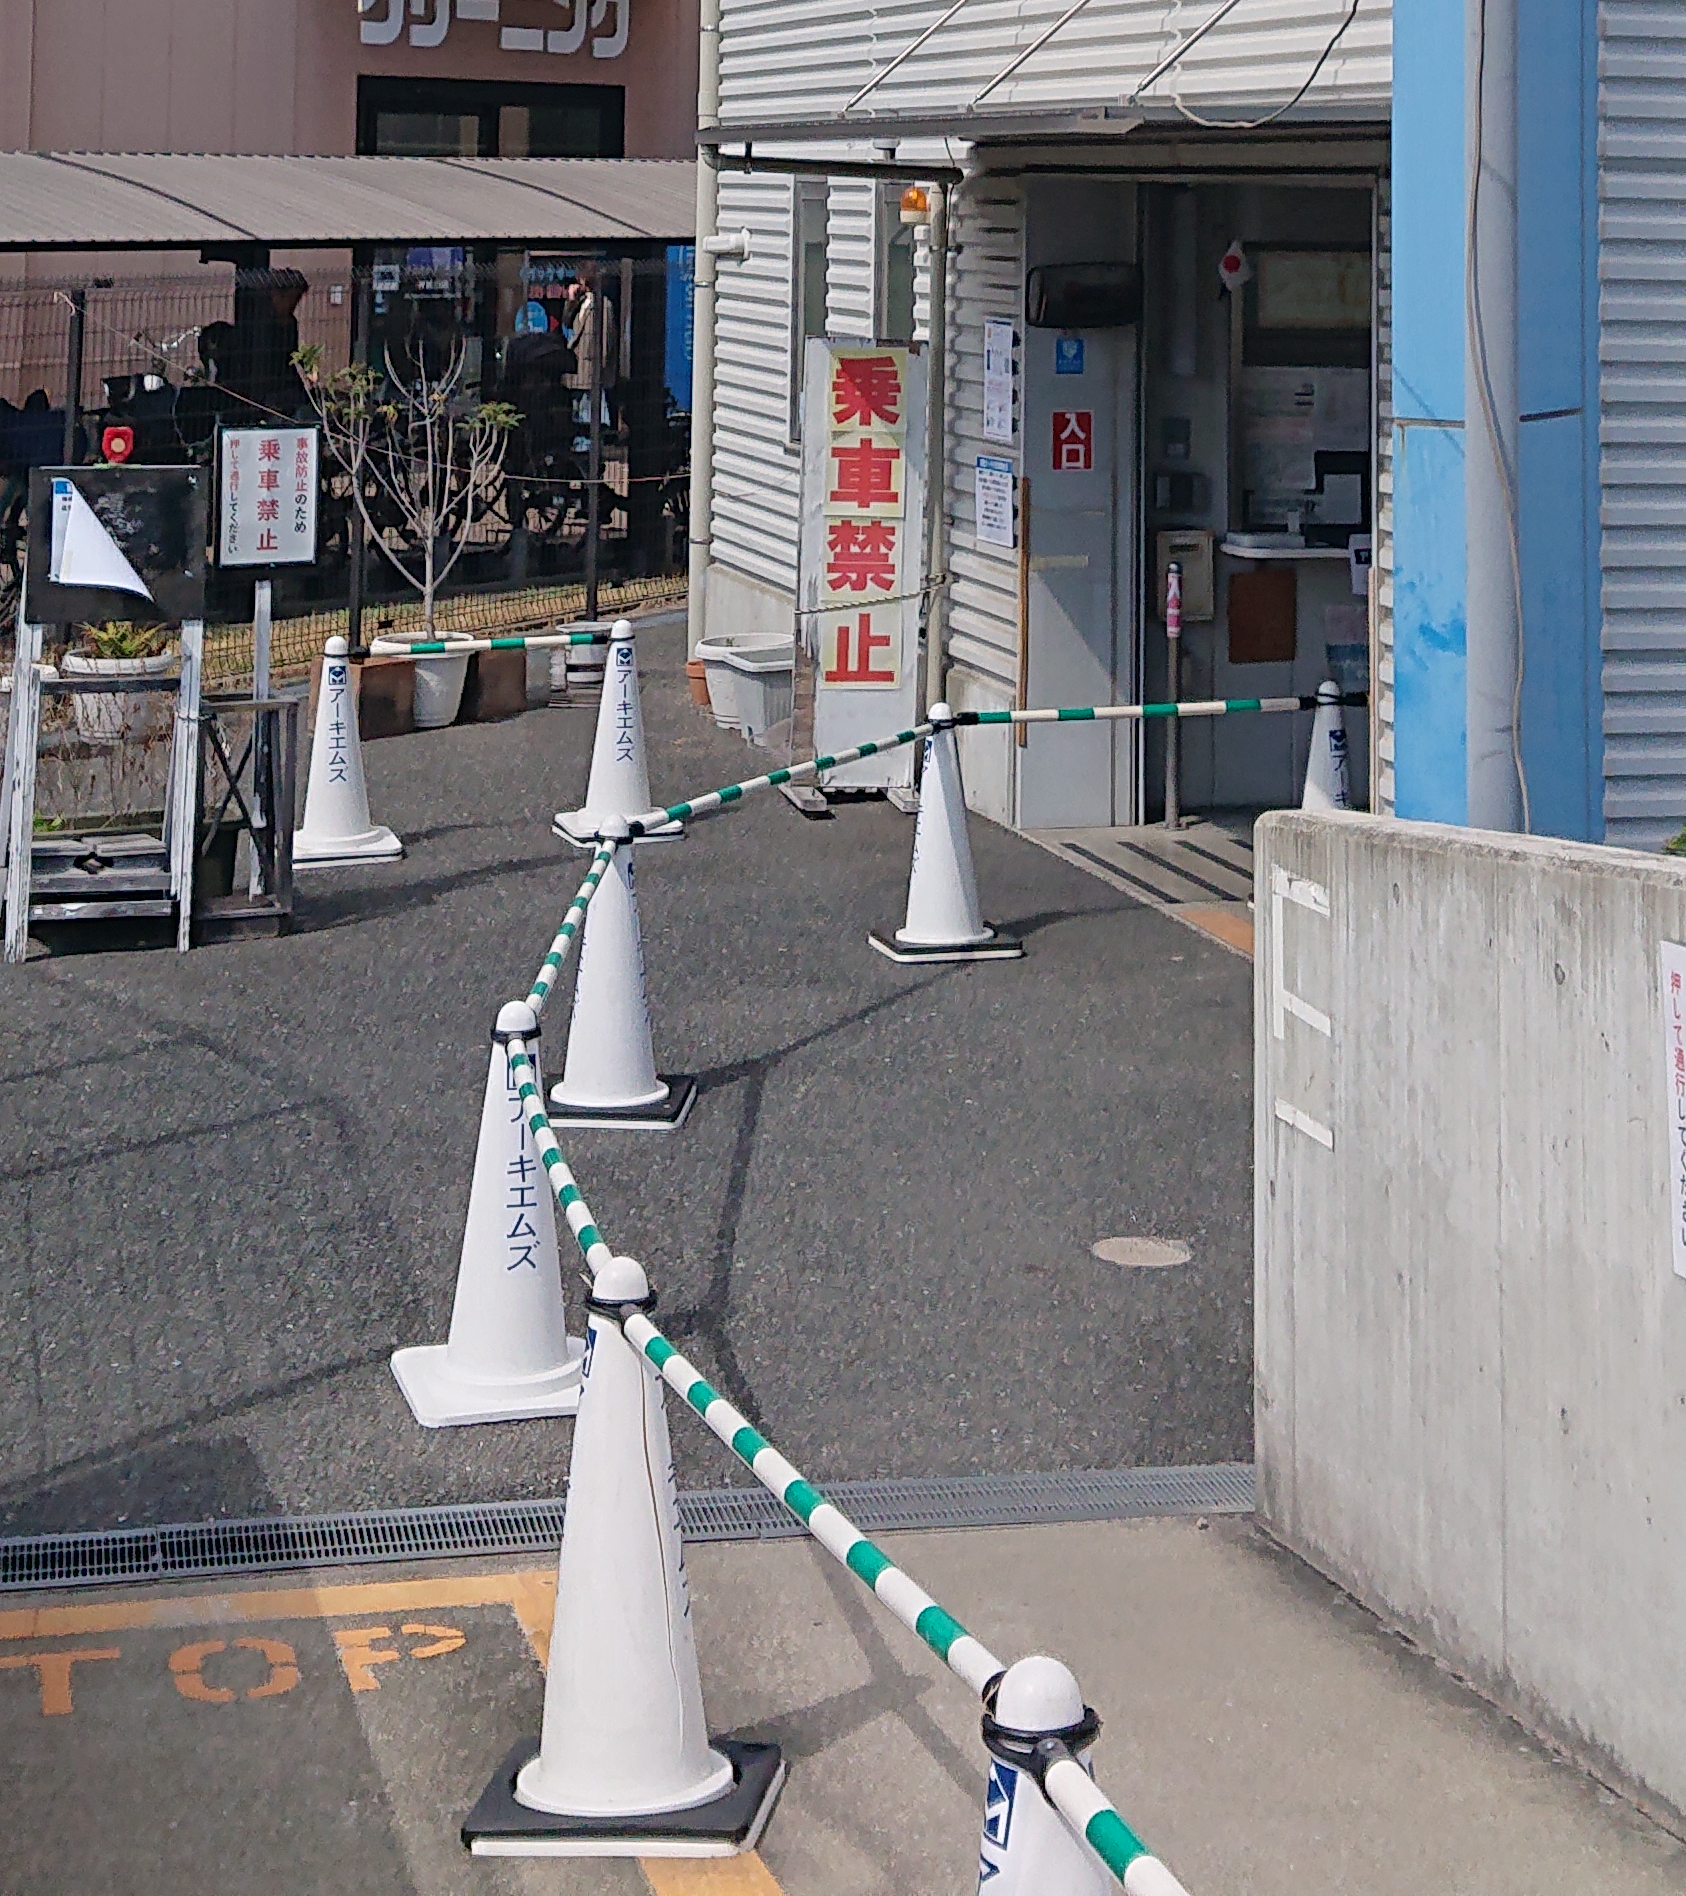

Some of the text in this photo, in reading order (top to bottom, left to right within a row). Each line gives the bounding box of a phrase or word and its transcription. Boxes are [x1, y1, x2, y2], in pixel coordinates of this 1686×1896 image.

[294, 436, 309, 533] 事故防止のため
[1059, 412, 1087, 470] 入口
[256, 438, 281, 551] 乗車禁止
[824, 356, 902, 684] 乗車禁止
[328, 688, 348, 782] アーキエムズ
[616, 669, 634, 762] アーキエムズ
